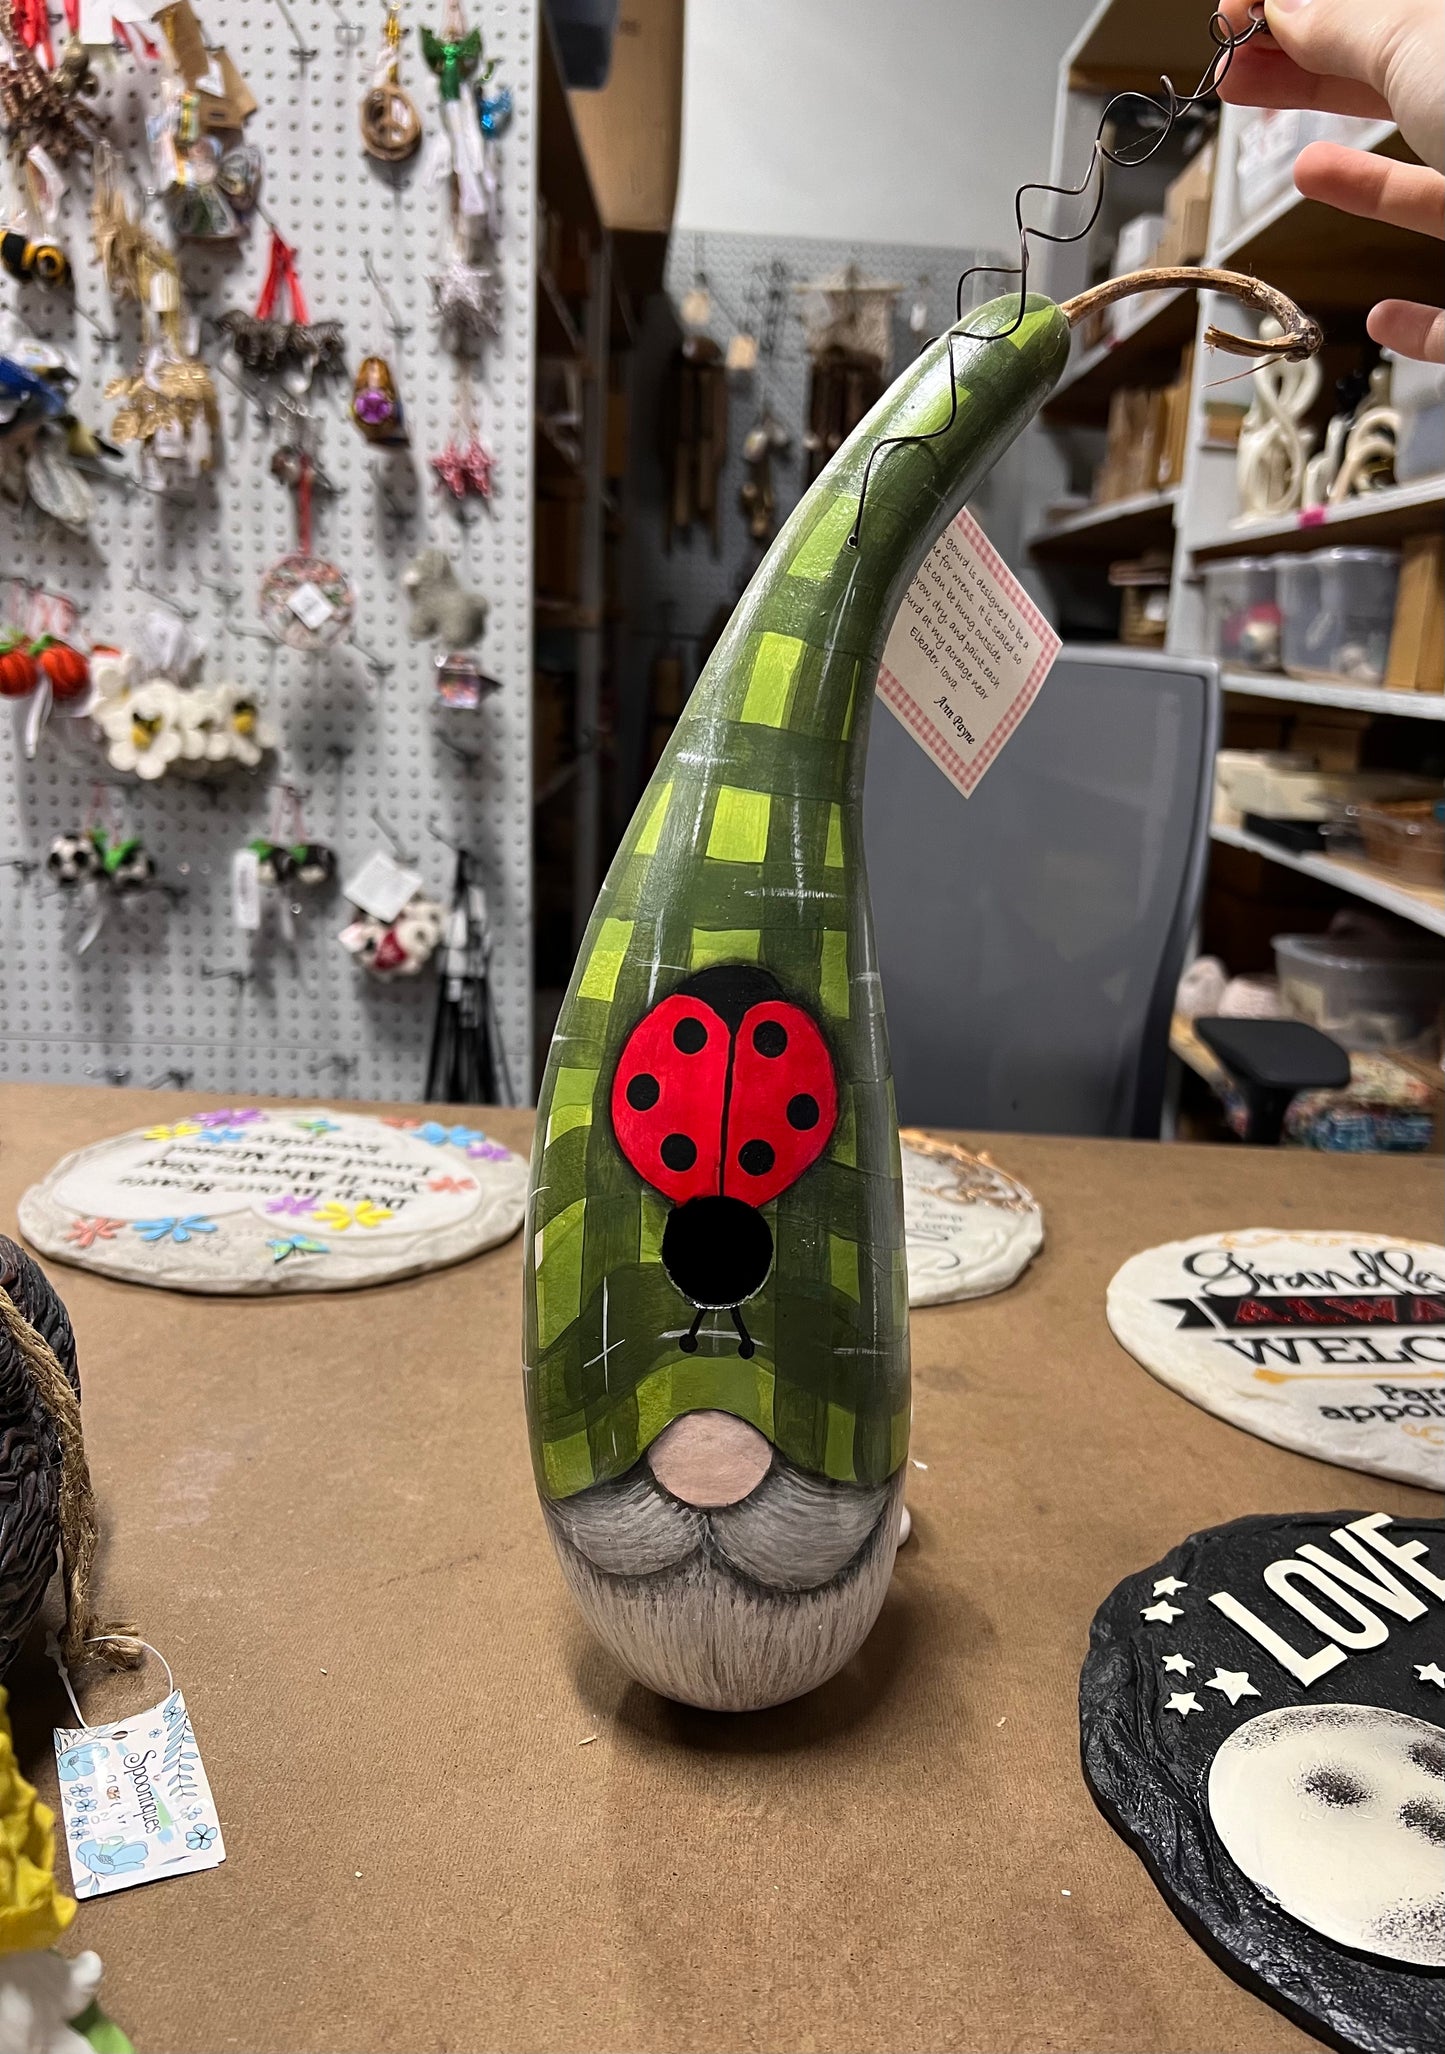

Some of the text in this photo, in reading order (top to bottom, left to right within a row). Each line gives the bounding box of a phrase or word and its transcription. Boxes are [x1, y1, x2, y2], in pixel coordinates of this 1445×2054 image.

[923, 558, 933, 573] it
[931, 571, 946, 592] can
[946, 587, 956, 604] be
[954, 599, 976, 633] hung
[939, 554, 953, 571] for
[984, 611, 993, 627] is
[991, 625, 1016, 655] sealed
[1012, 652, 1022, 665] so
[945, 538, 970, 569] gourd
[968, 565, 977, 580] is
[976, 579, 1009, 621] designed
[1008, 618, 1016, 632] to
[1015, 627, 1024, 644] be
[904, 592, 989, 700] ourd at my acreage near
[910, 626, 940, 669] Elkader,
[949, 622, 967, 643] and
[962, 641, 985, 669] paint
[983, 667, 1000, 690] each
[933, 696, 976, 745] Ann Payne
[1207, 1511, 1445, 1688] LOVE
[123, 1749, 163, 1835] Spoontiques
